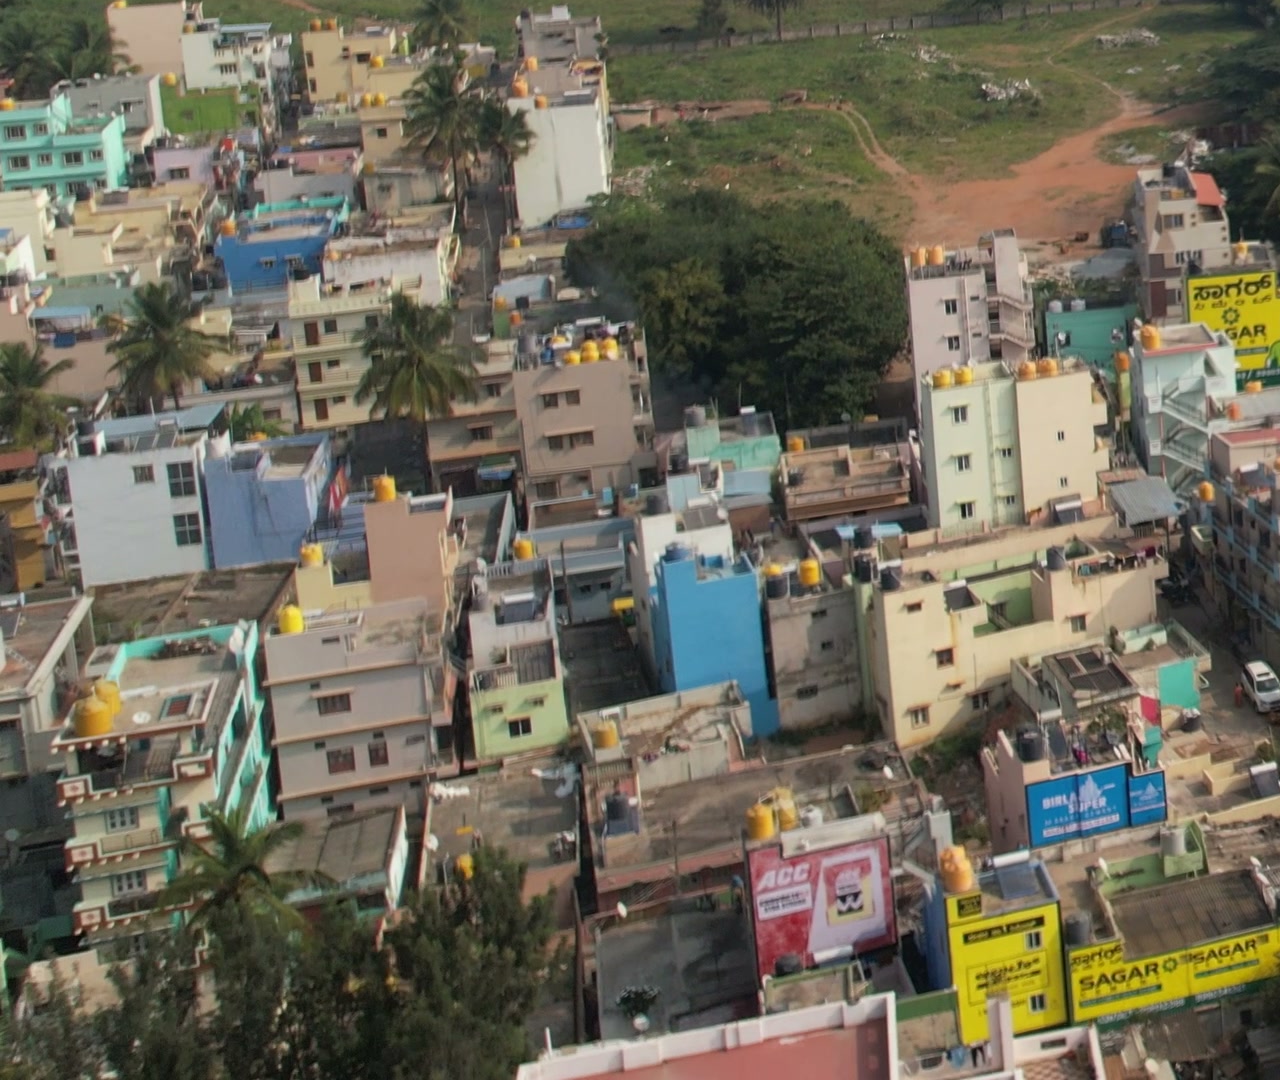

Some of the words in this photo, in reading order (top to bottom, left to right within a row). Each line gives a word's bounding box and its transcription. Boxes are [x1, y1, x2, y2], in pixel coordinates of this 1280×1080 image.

[1215, 324, 1265, 340] GAR
[1042, 792, 1077, 810] BIRLA
[1068, 796, 1106, 814] SUPER
[757, 863, 810, 891] ACC
[1193, 940, 1257, 964] SAGAR
[1080, 962, 1158, 990] SAGAR
